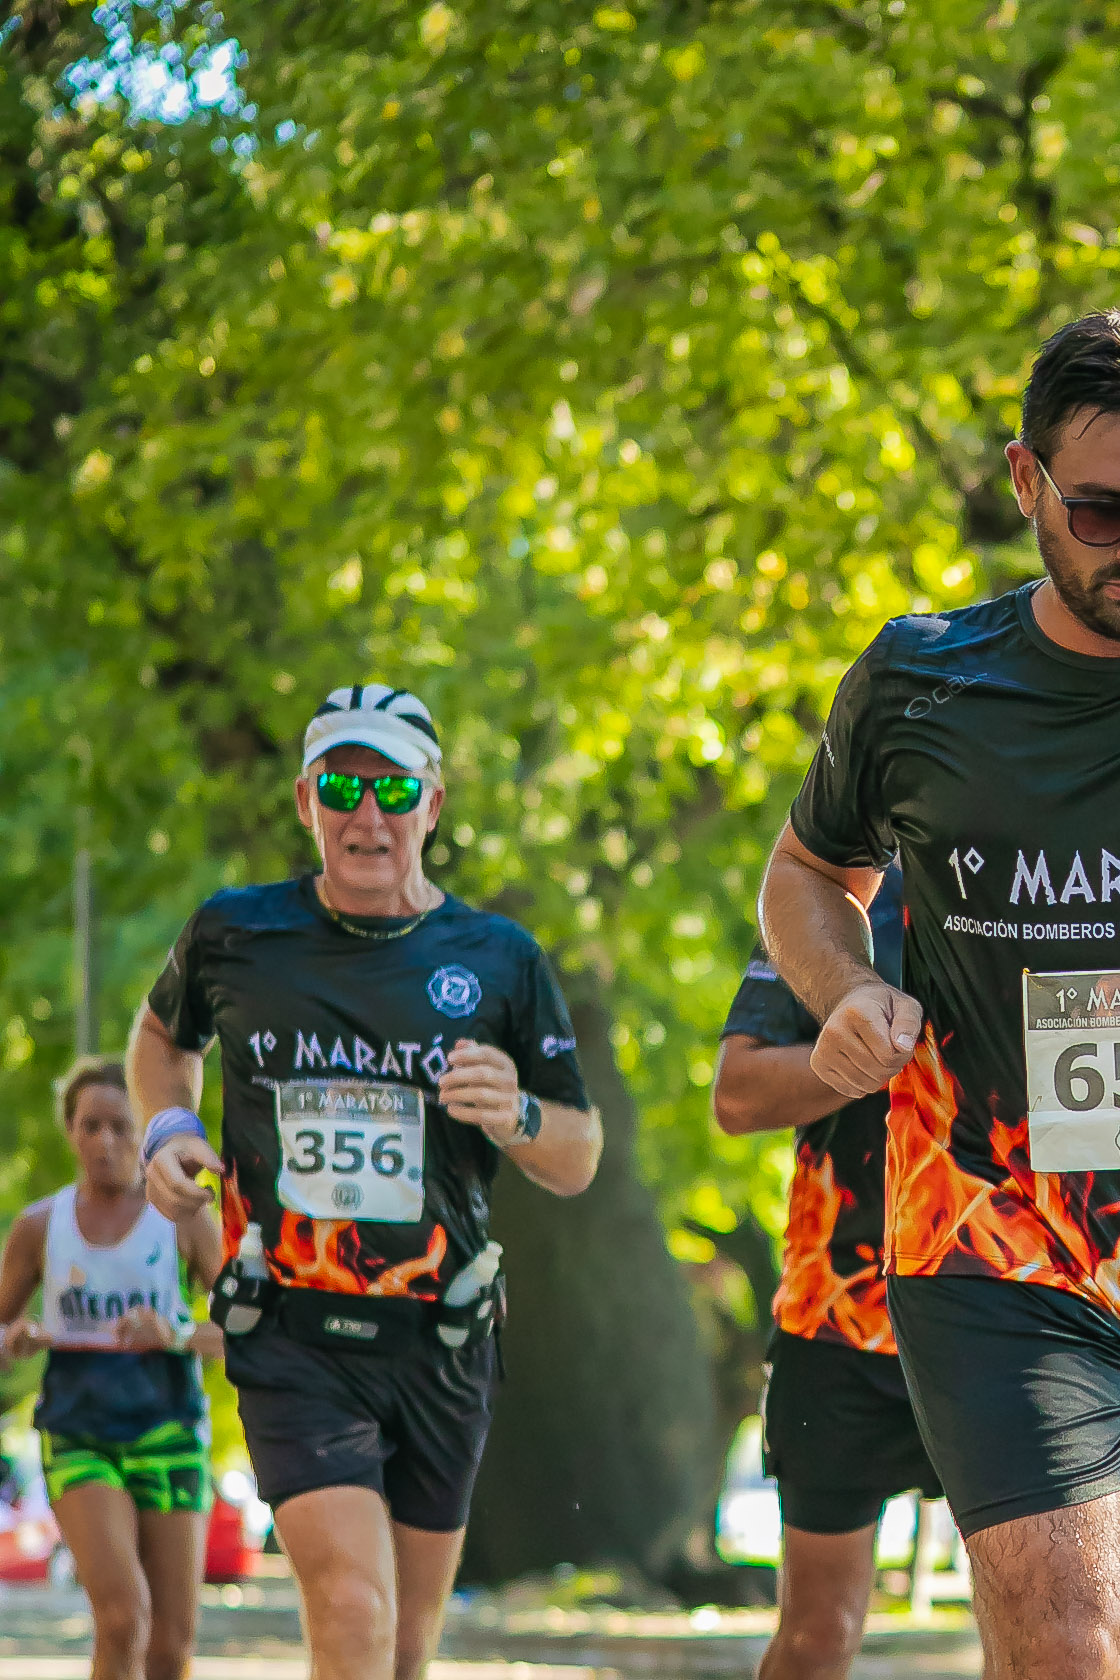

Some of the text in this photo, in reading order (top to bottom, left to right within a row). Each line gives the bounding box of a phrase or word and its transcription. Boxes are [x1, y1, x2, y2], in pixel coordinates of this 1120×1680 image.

[943, 914, 1018, 939] ASOCIACIÓN
[1022, 922, 1115, 941] BOMBEROS
[1036, 1016, 1088, 1029] ASOCIACIÓN
[294, 1028, 449, 1084] MARATÓ
[290, 1128, 405, 1177] 356
